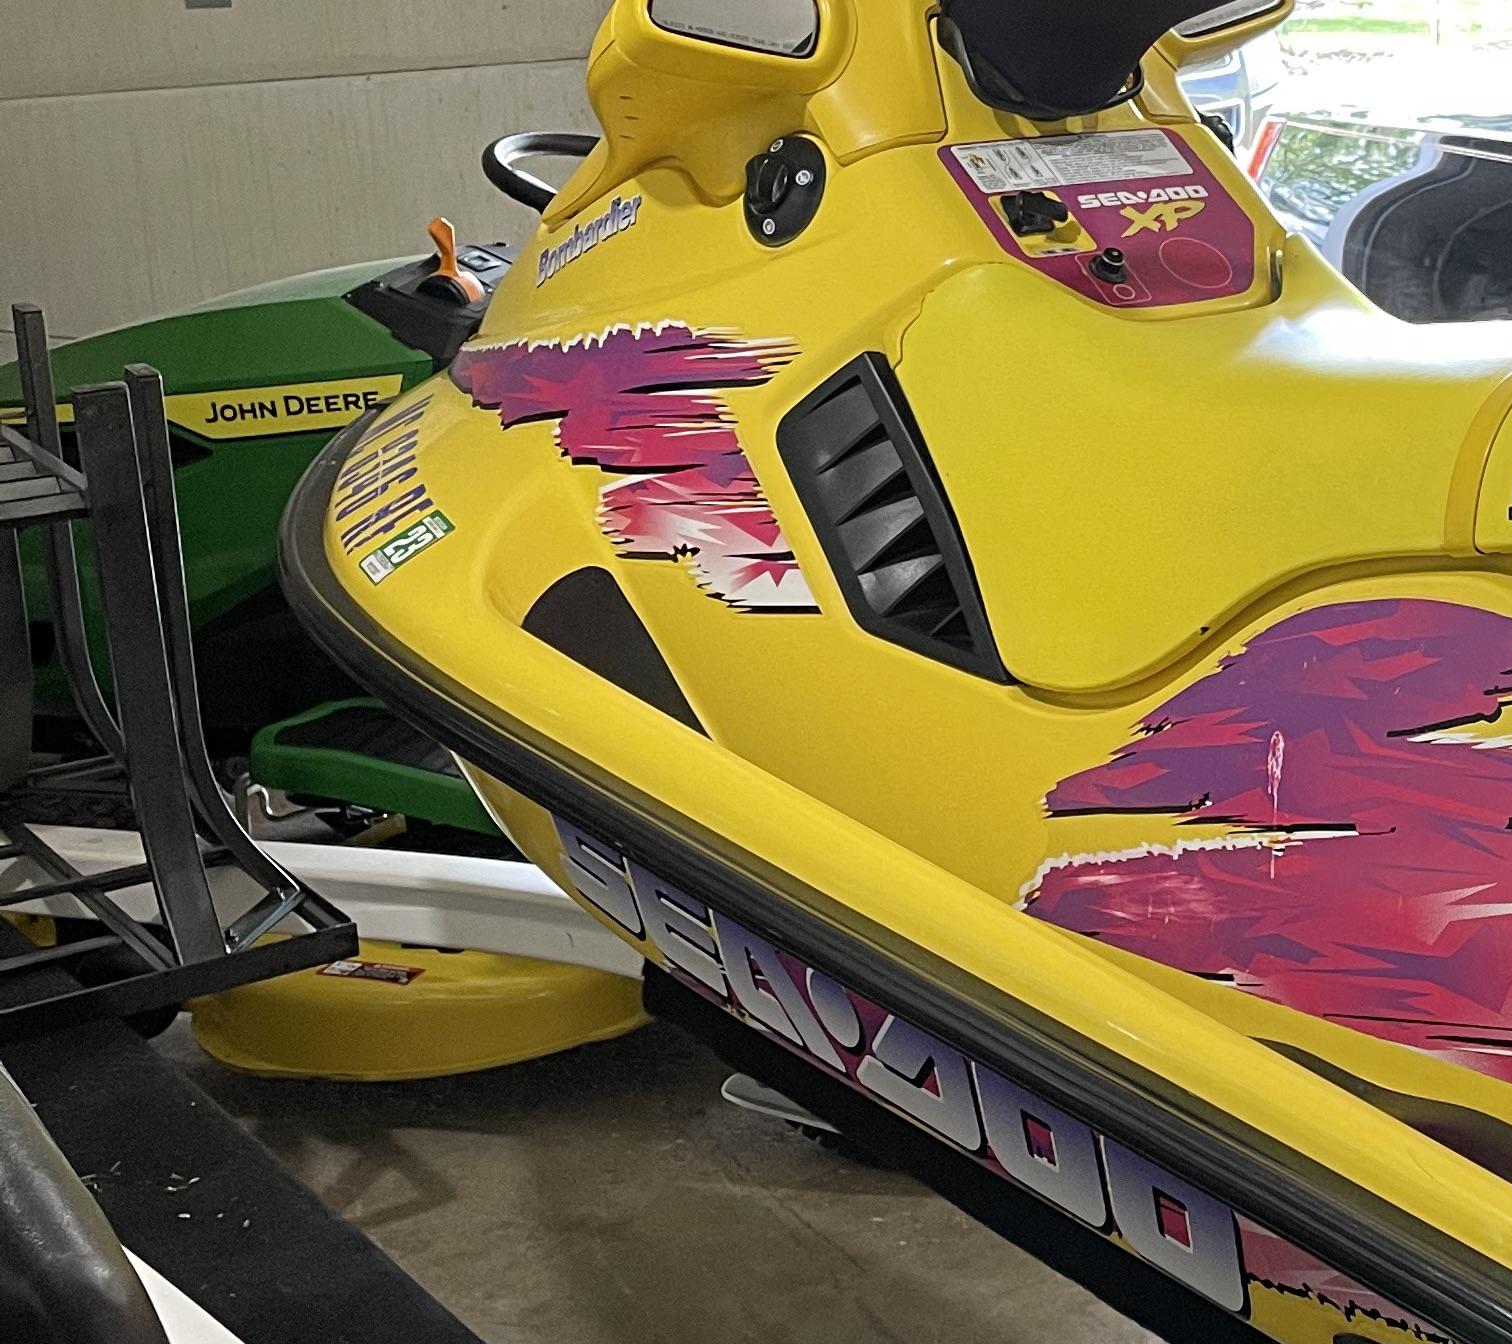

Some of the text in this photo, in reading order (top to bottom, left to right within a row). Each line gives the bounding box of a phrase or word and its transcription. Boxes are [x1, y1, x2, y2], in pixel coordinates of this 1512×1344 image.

[1120, 199, 1206, 238] XP
[536, 196, 642, 288] Bombardier
[204, 390, 379, 424] JOHN DEERE
[382, 524, 434, 564] 23
